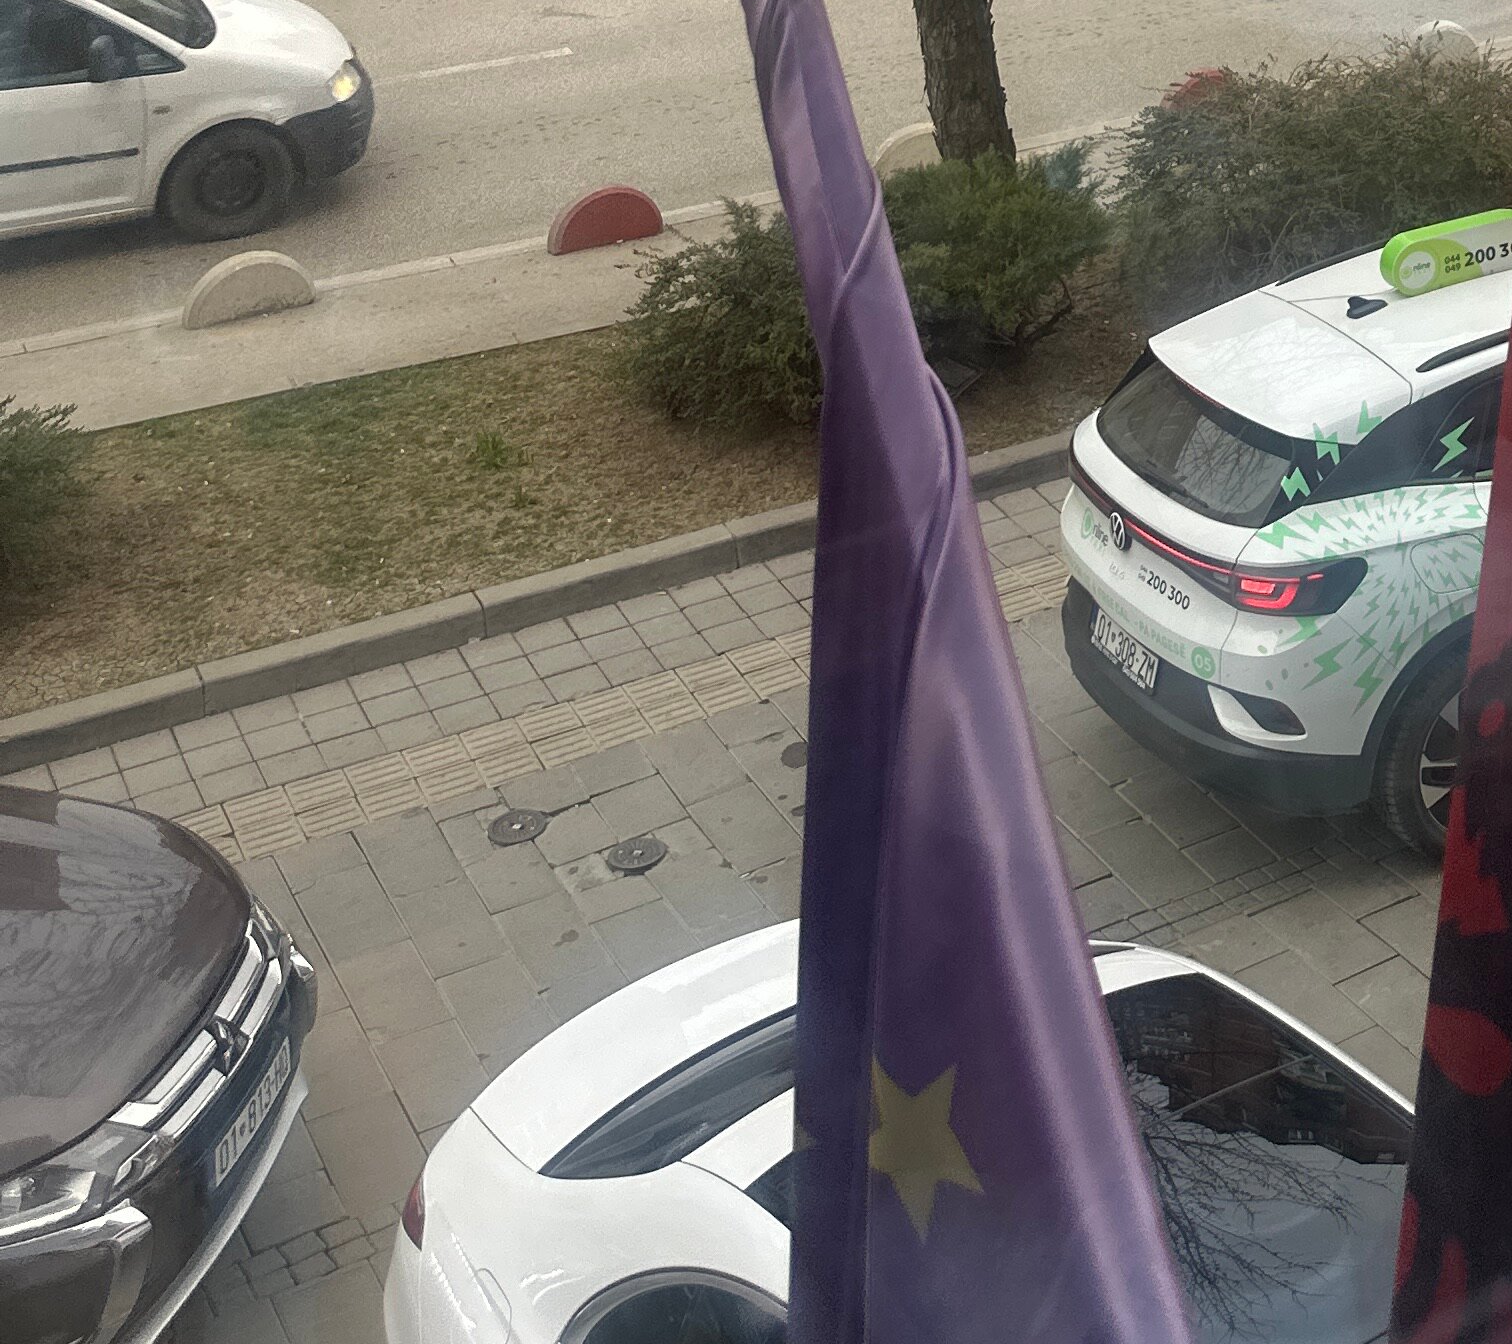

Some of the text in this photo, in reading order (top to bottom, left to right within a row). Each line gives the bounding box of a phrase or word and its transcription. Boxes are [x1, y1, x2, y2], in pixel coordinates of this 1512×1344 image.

[1464, 247, 1496, 268] 200
[1146, 570, 1167, 595] 200
[1167, 585, 1191, 610] 300
